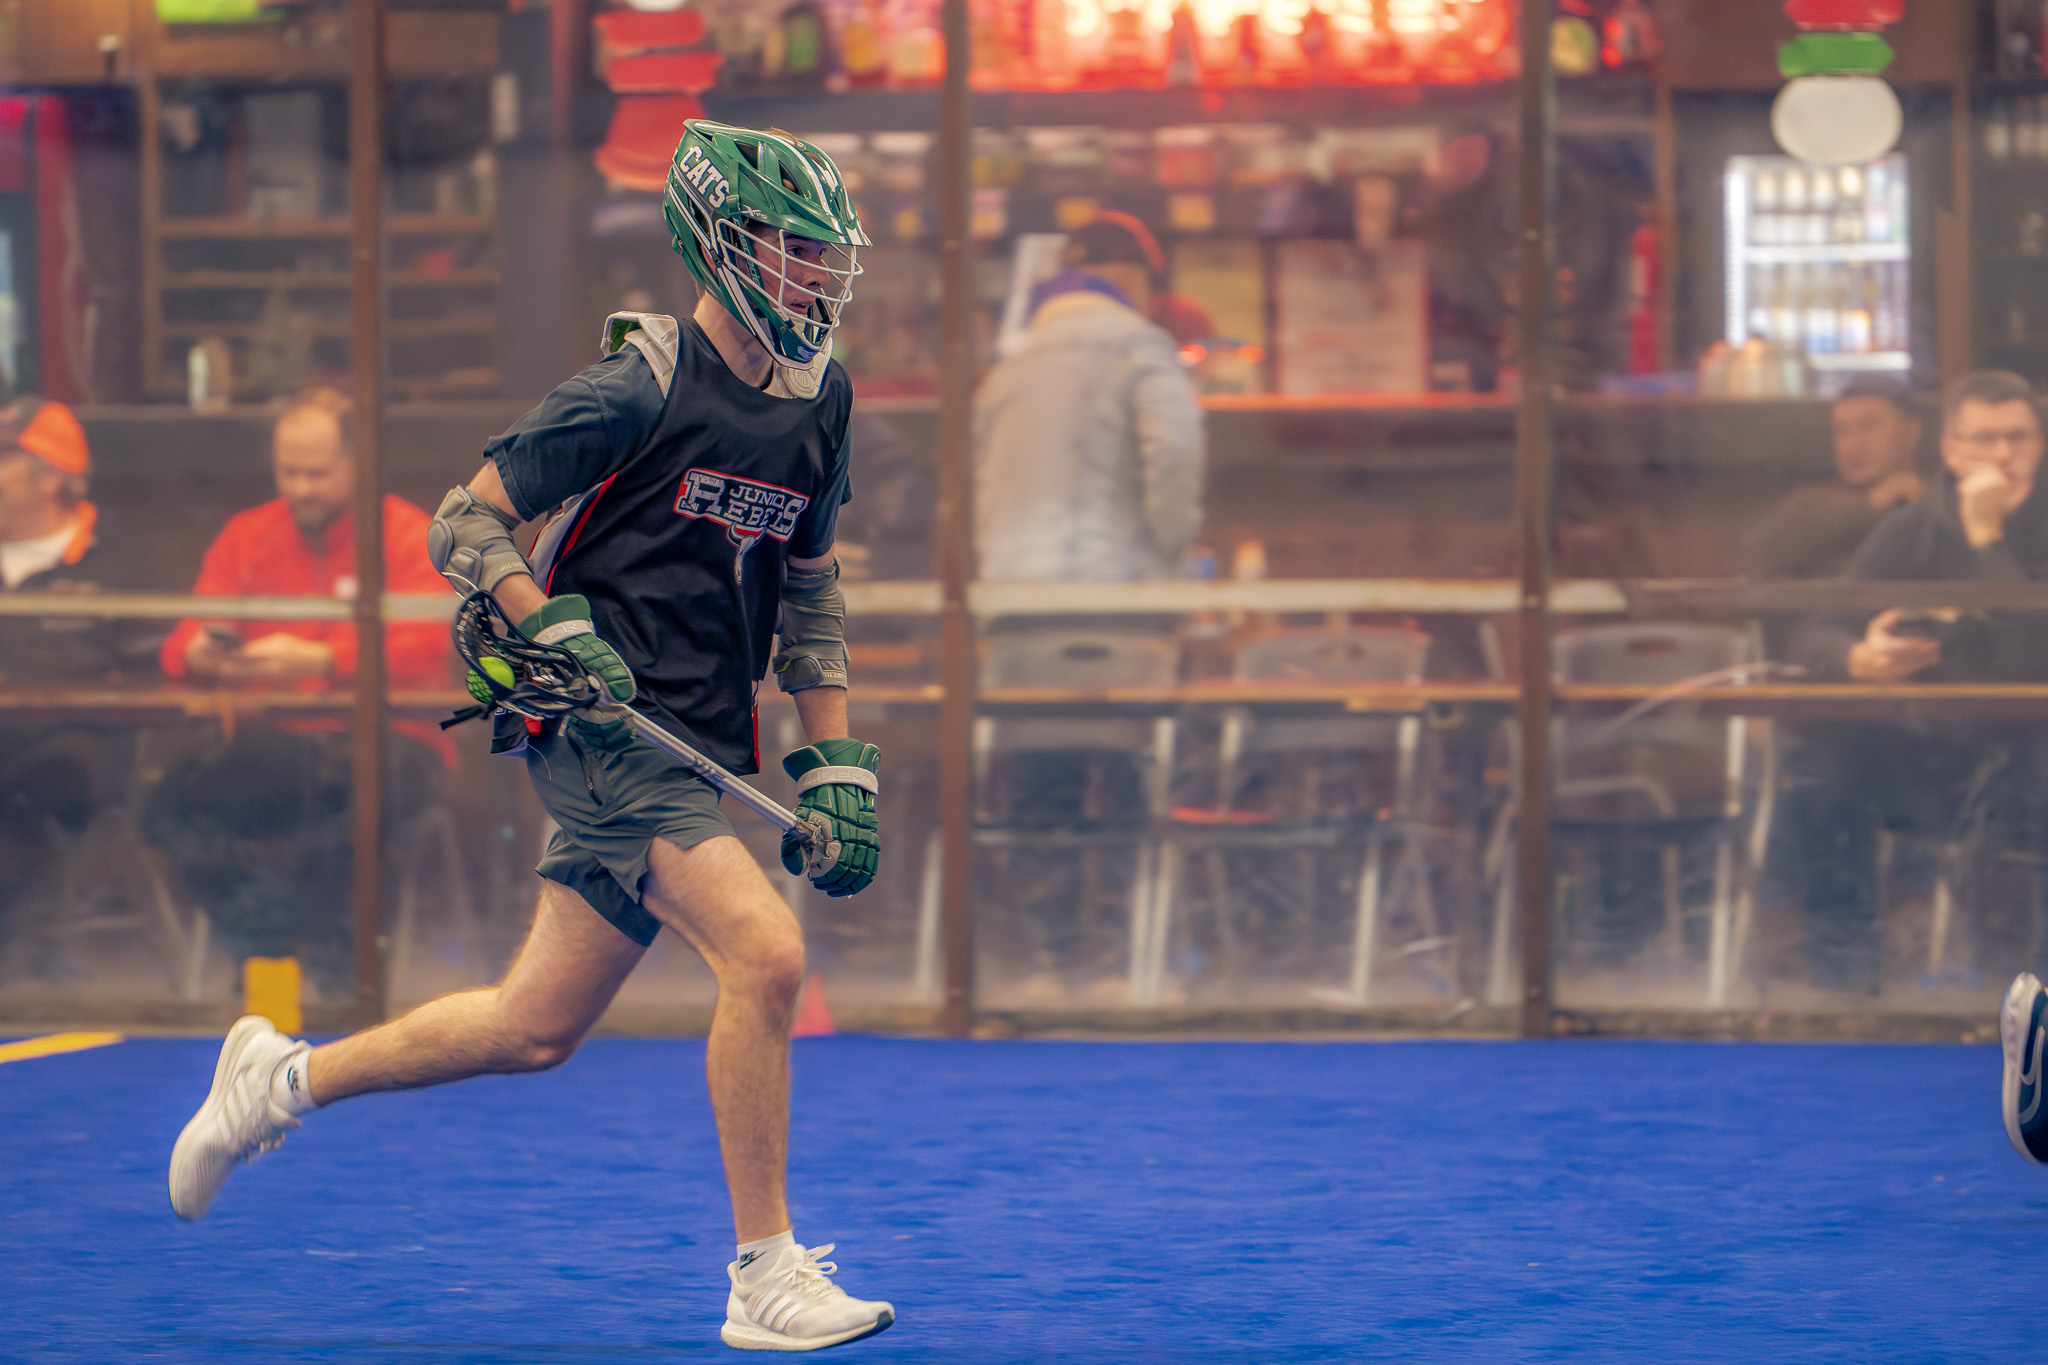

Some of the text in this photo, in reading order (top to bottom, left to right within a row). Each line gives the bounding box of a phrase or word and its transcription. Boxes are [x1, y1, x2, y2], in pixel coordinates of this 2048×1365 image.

[680, 146, 730, 208] CATS
[680, 472, 805, 534] REBELS
[729, 485, 786, 509] JUNIO
